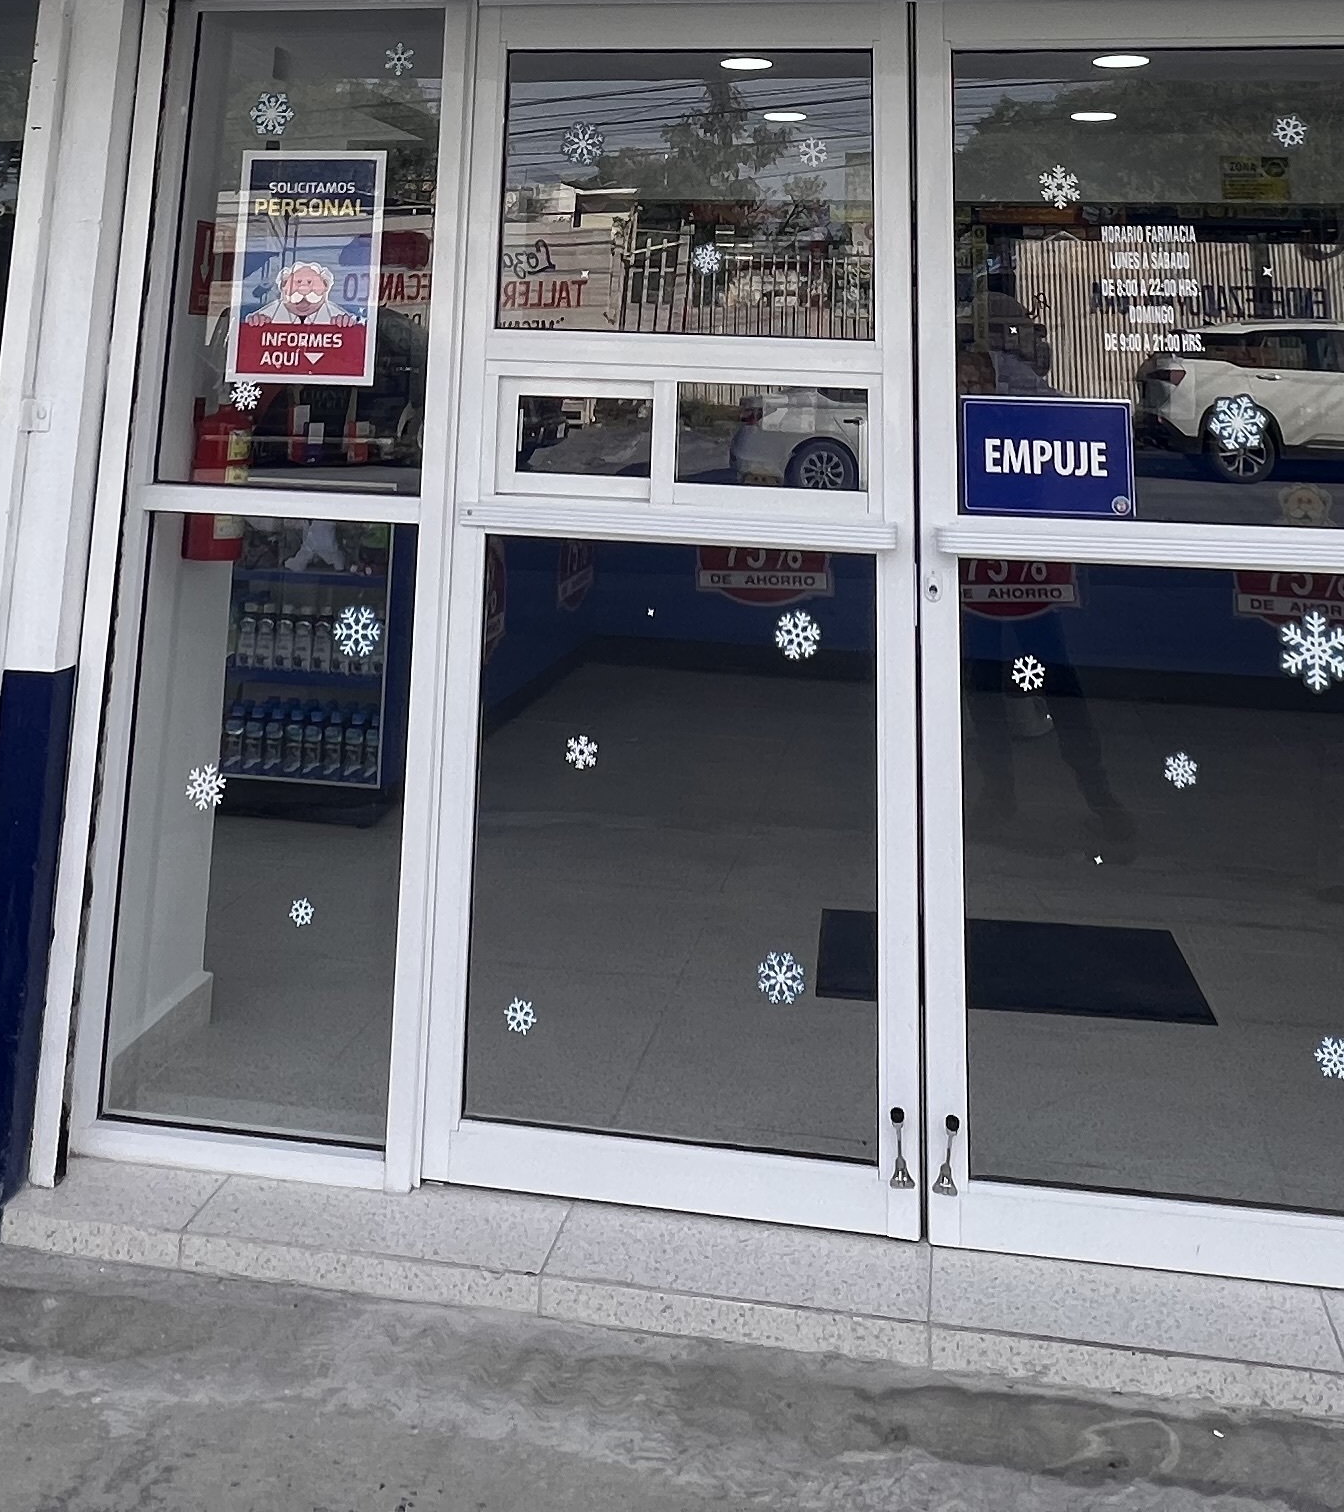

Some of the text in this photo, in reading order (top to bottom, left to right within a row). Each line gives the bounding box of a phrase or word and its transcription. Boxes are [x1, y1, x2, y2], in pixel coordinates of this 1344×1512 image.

[269, 181, 356, 194] SOLICITAMOS
[254, 198, 368, 217] PERSONAL
[1101, 225, 1196, 243] HORARIO FARMACIA
[1110, 251, 1140, 270] LUNES
[1142, 252, 1149, 269] A
[1101, 278, 1115, 297] DE
[1116, 278, 1138, 297] 8:00
[1140, 279, 1148, 297] A
[1149, 278, 1176, 297] 22:00
[1178, 278, 1202, 297] HRS.
[1129, 305, 1175, 324] DOMINGO
[261, 332, 343, 348] INFORMES
[1104, 333, 1206, 352] DE 9:00 A 21:00 HRS.
[259, 349, 300, 369] AQUÍ
[984, 437, 1108, 477] EMPUJE
[710, 573, 816, 587] DE AHORRO
[987, 588, 1063, 599] AHORRO
[1250, 598, 1275, 611] DE
